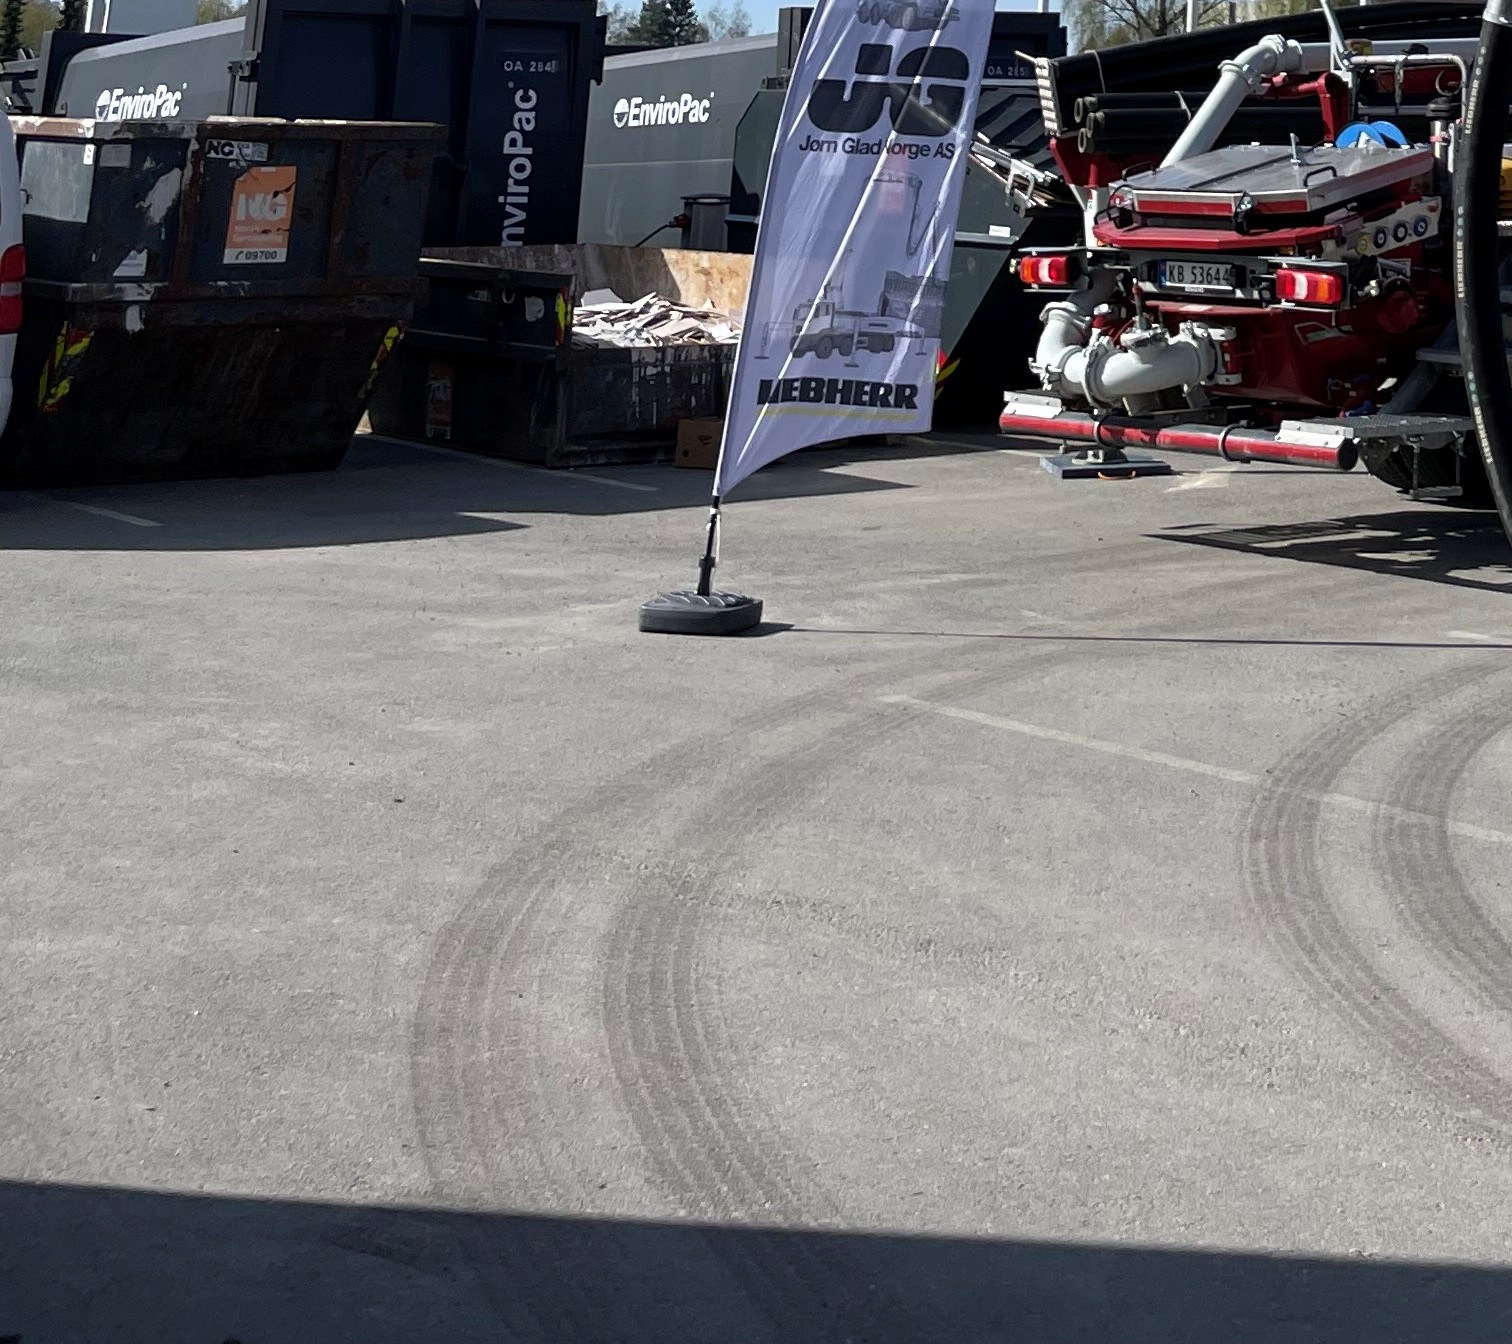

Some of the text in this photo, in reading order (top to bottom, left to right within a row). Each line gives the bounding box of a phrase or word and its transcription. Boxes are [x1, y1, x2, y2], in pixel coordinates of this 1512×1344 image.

[627, 93, 710, 127] EnviroPac
[208, 140, 234, 156] NG
[842, 137, 881, 155] Glad
[887, 142, 930, 159] orge
[932, 142, 956, 159] AS
[1168, 264, 1230, 285] KB 53644
